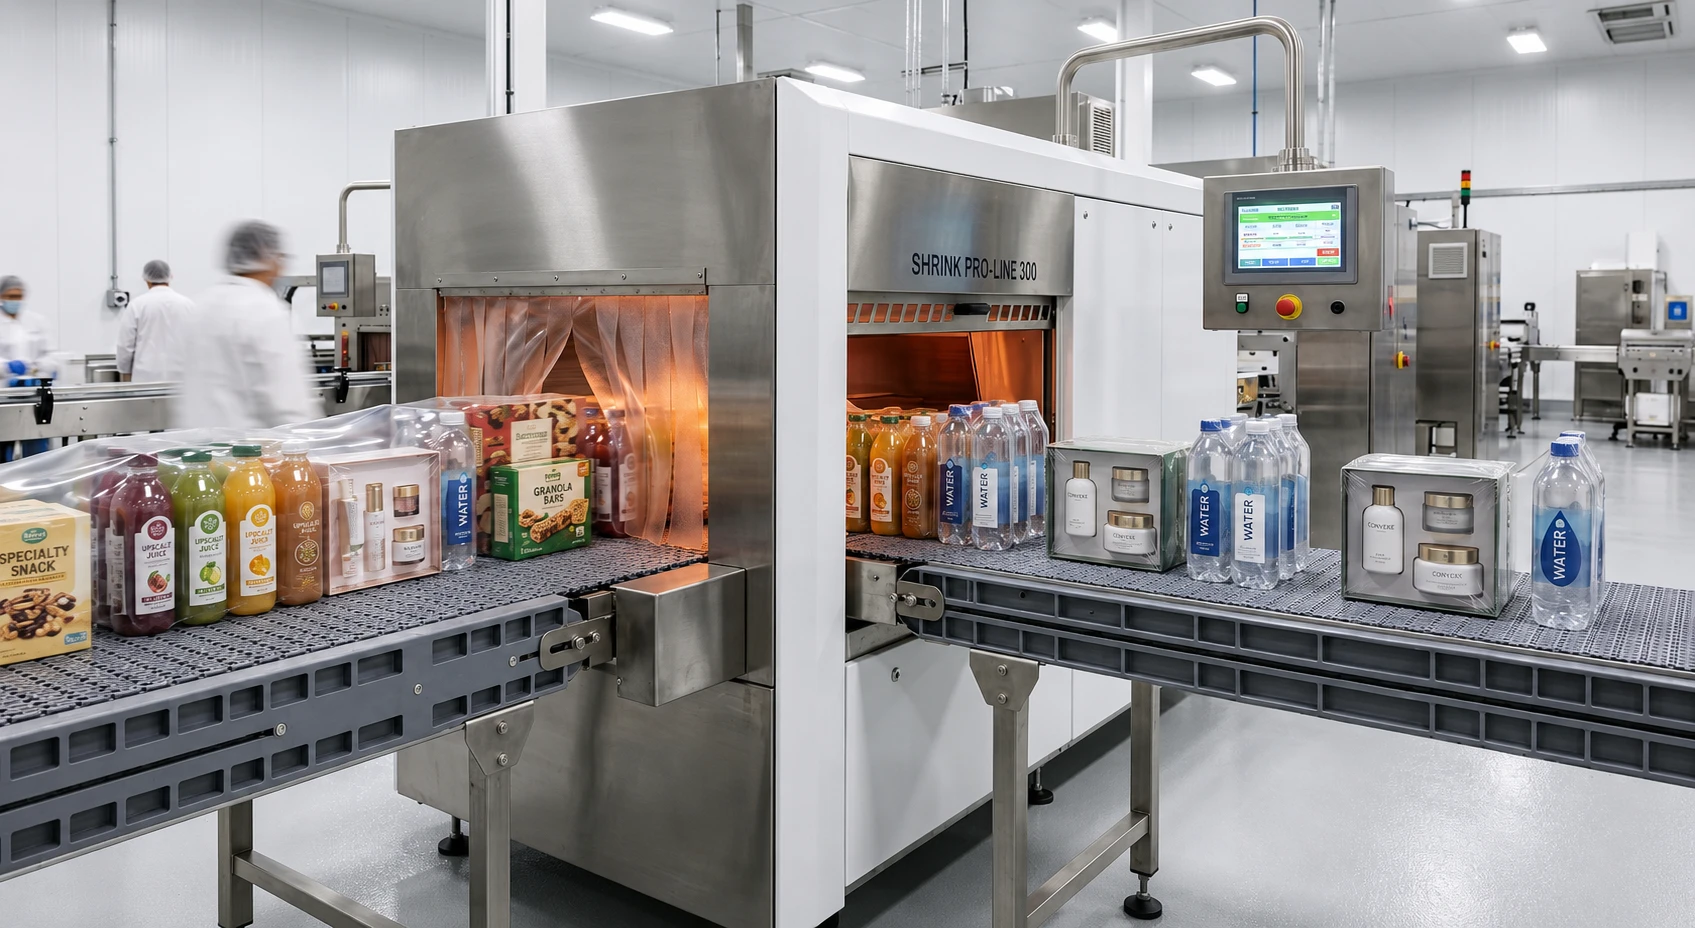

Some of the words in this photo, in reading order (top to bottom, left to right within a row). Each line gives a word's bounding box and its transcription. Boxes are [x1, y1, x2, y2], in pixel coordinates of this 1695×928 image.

[911, 252, 962, 278] SHRINK
[964, 256, 1017, 281] PRO-LINE
[1019, 261, 1037, 281] 300
[458, 484, 468, 527] WATER
[533, 482, 573, 497] GRANOLA
[543, 493, 565, 505] BARS
[946, 469, 955, 507] WATER
[980, 472, 988, 509] WATER
[1199, 495, 1210, 537] WATER
[1243, 499, 1253, 541] WATER
[0, 545, 69, 565] SPECIALTY
[11, 560, 56, 577] SNACK
[1553, 530, 1567, 580] WATER
